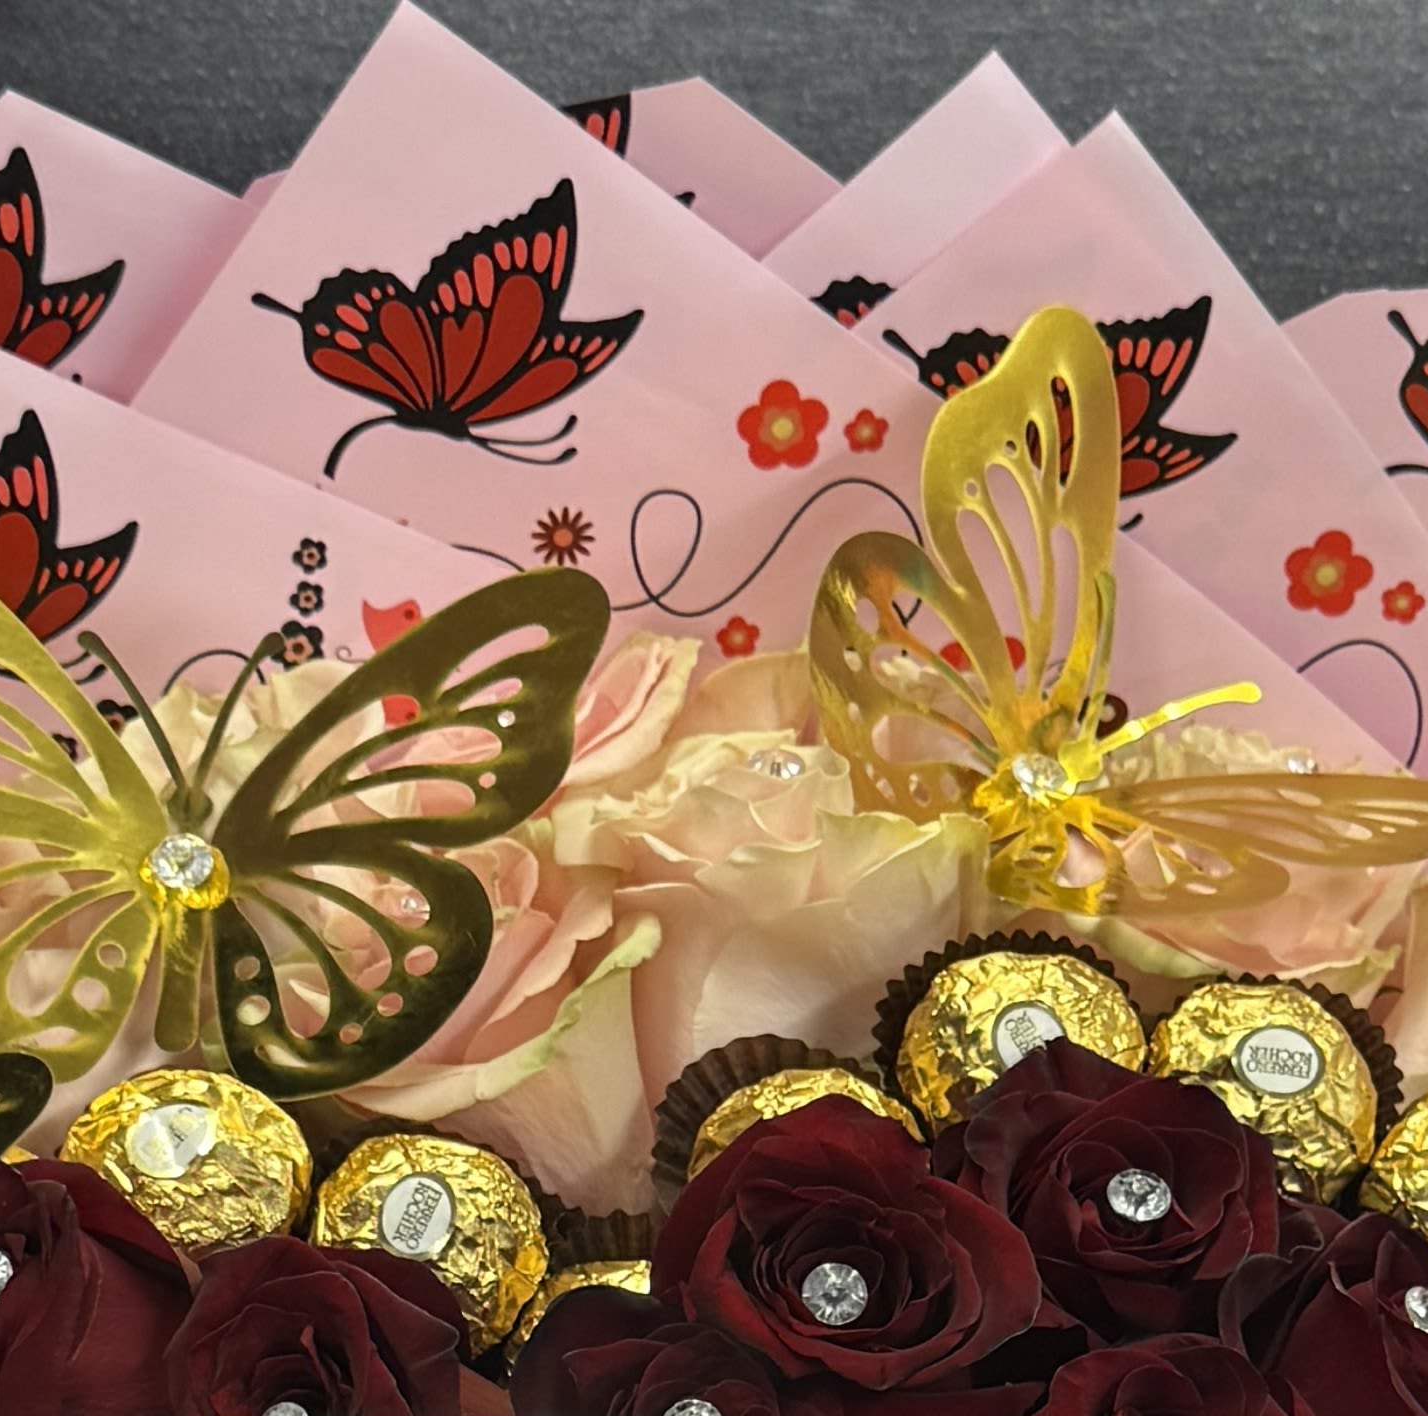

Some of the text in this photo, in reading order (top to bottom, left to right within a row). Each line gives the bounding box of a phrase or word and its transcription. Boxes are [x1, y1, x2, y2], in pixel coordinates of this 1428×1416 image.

[1246, 1057, 1313, 1079] FERRERO
[1248, 1046, 1313, 1066] ROCHER
[390, 1180, 432, 1244] ROCHER
[405, 1187, 444, 1251] FERRERO
